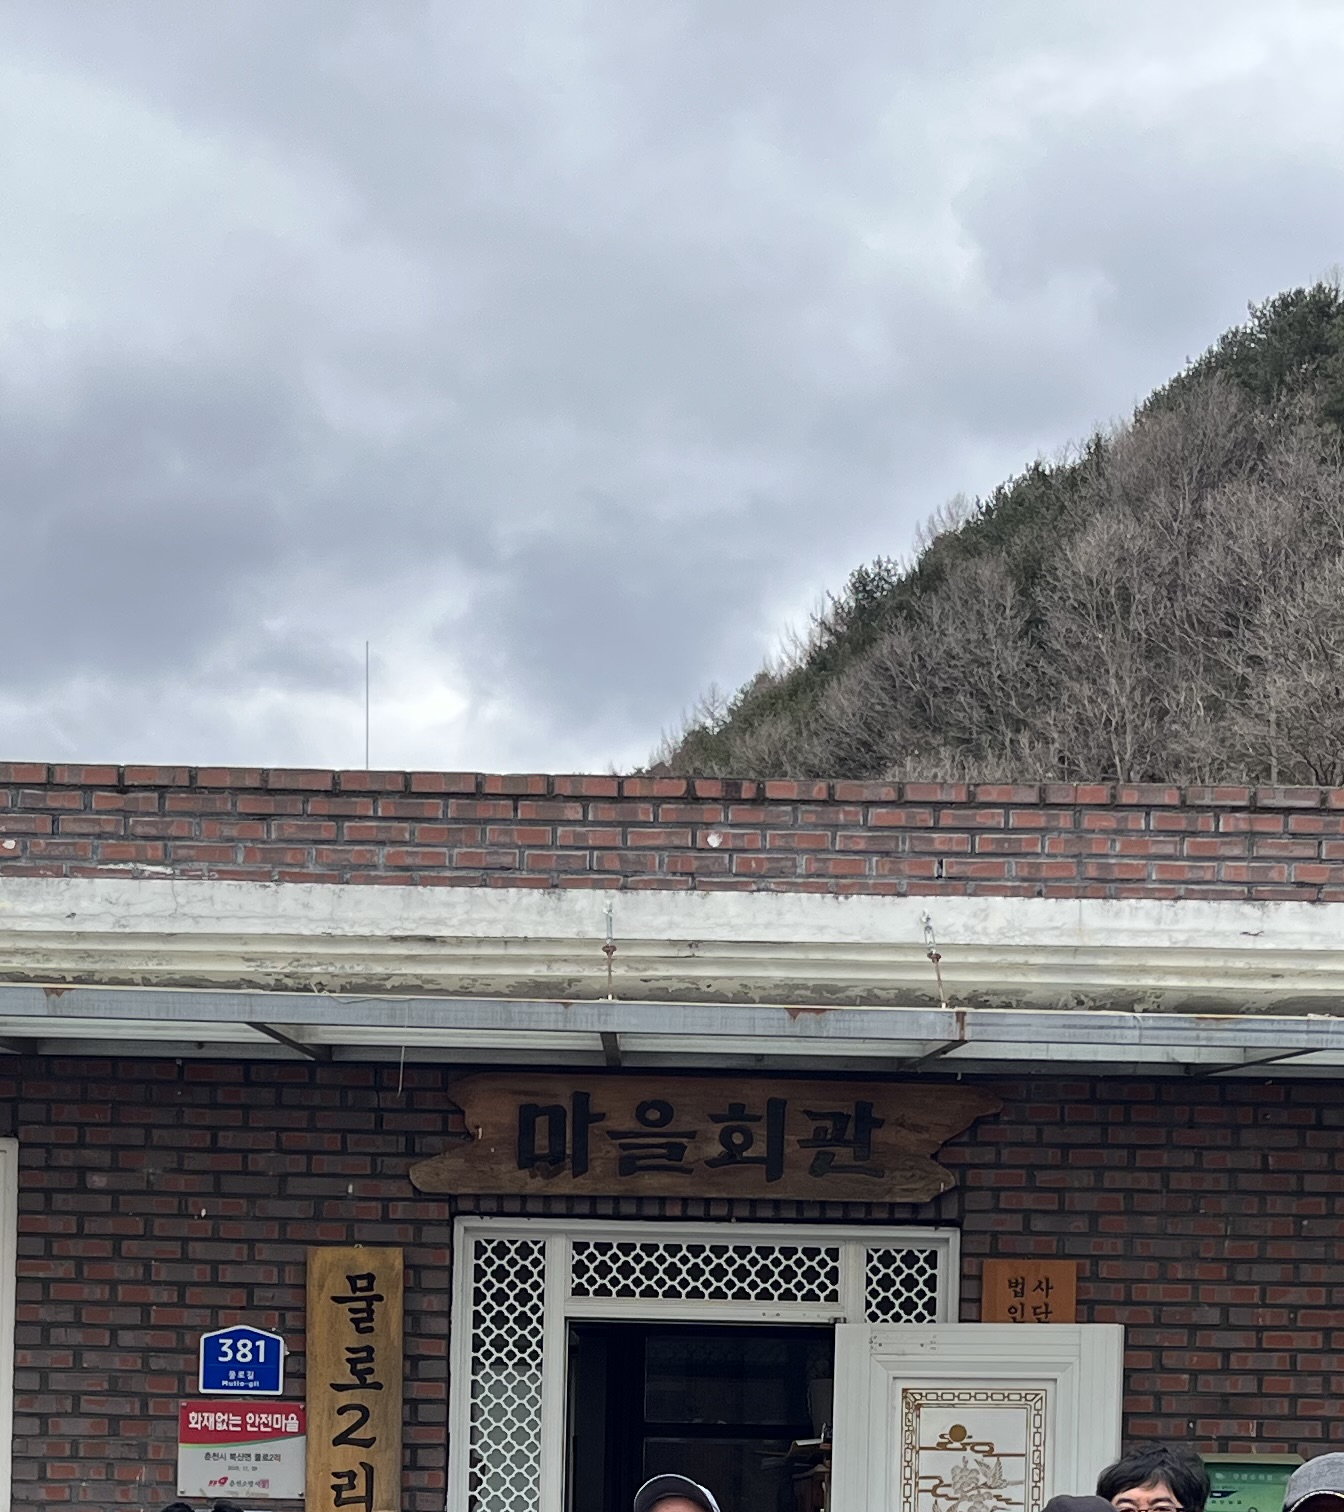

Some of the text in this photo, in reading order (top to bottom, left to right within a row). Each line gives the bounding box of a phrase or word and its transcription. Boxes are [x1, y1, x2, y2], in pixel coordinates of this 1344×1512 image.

[517, 1090, 886, 1183] 마을회관
[217, 1338, 266, 1363] 381
[188, 1411, 299, 1433] 화재없는 안전마을
